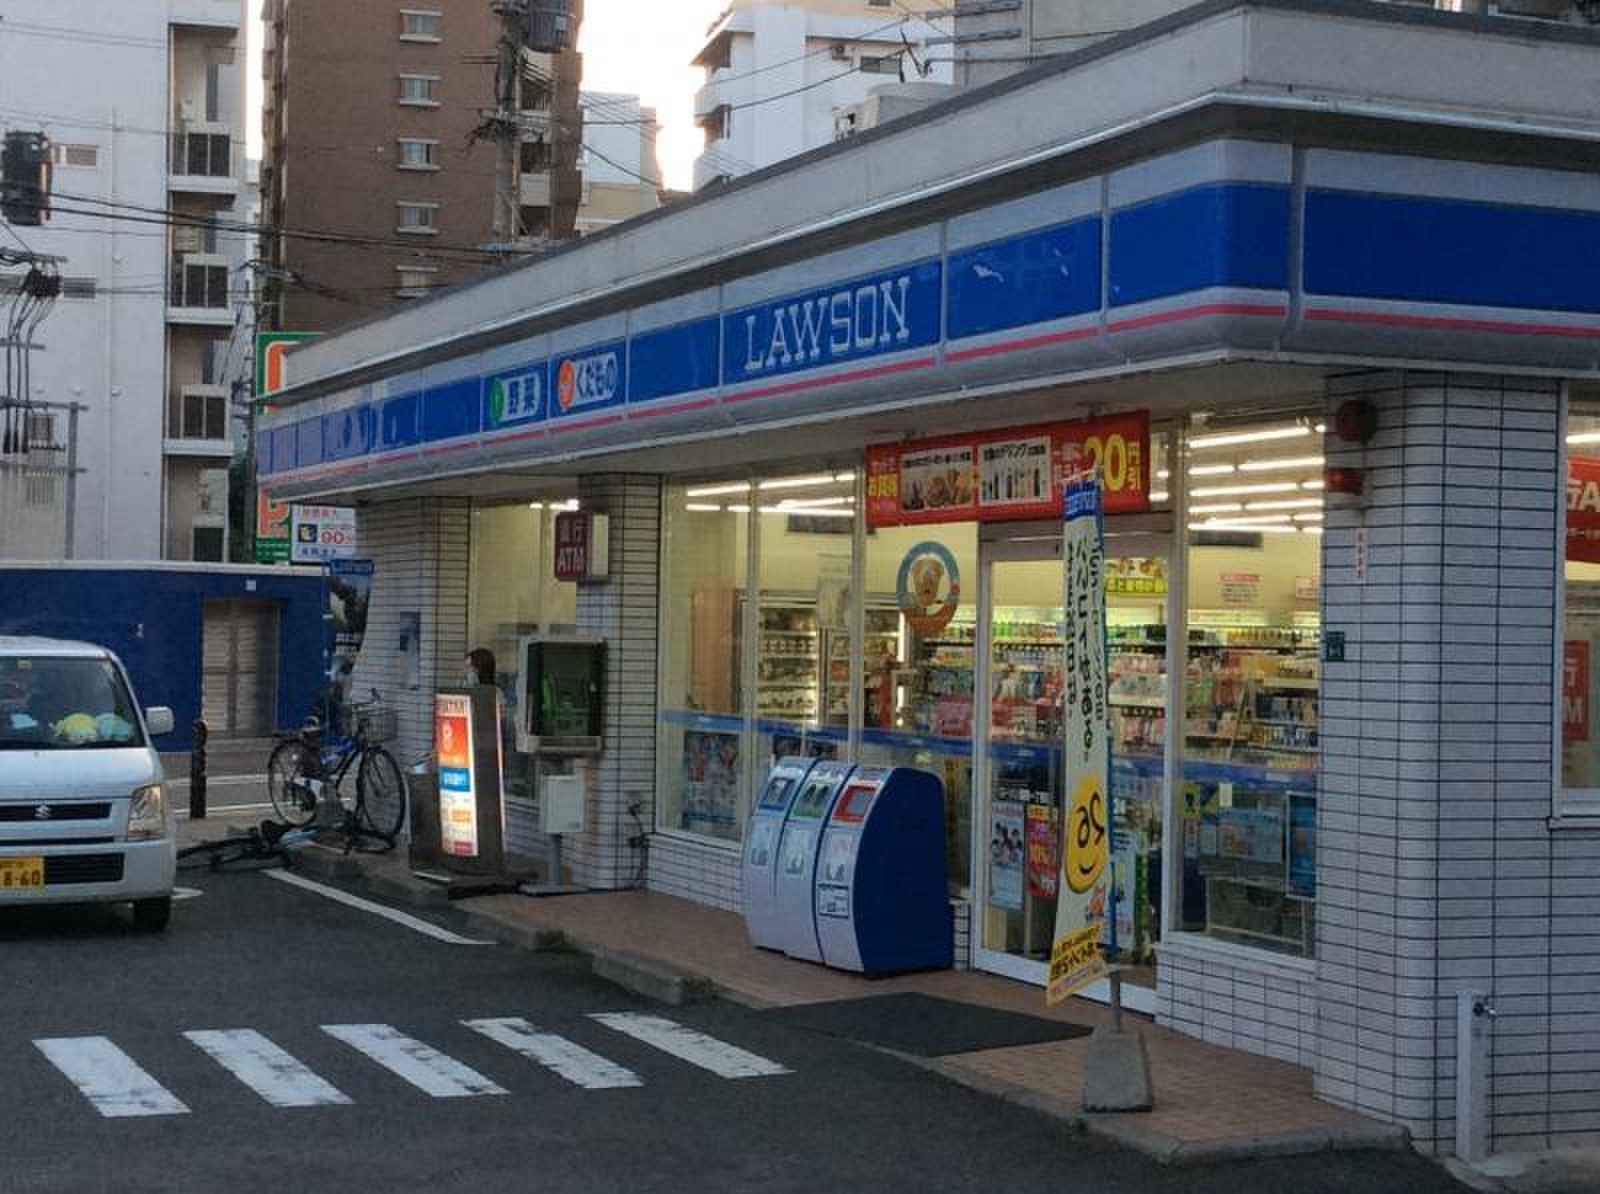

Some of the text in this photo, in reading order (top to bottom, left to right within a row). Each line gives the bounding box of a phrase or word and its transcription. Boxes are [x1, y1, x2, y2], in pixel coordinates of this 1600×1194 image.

[744, 275, 911, 371] LAWSON
[576, 358, 618, 399] くだもの
